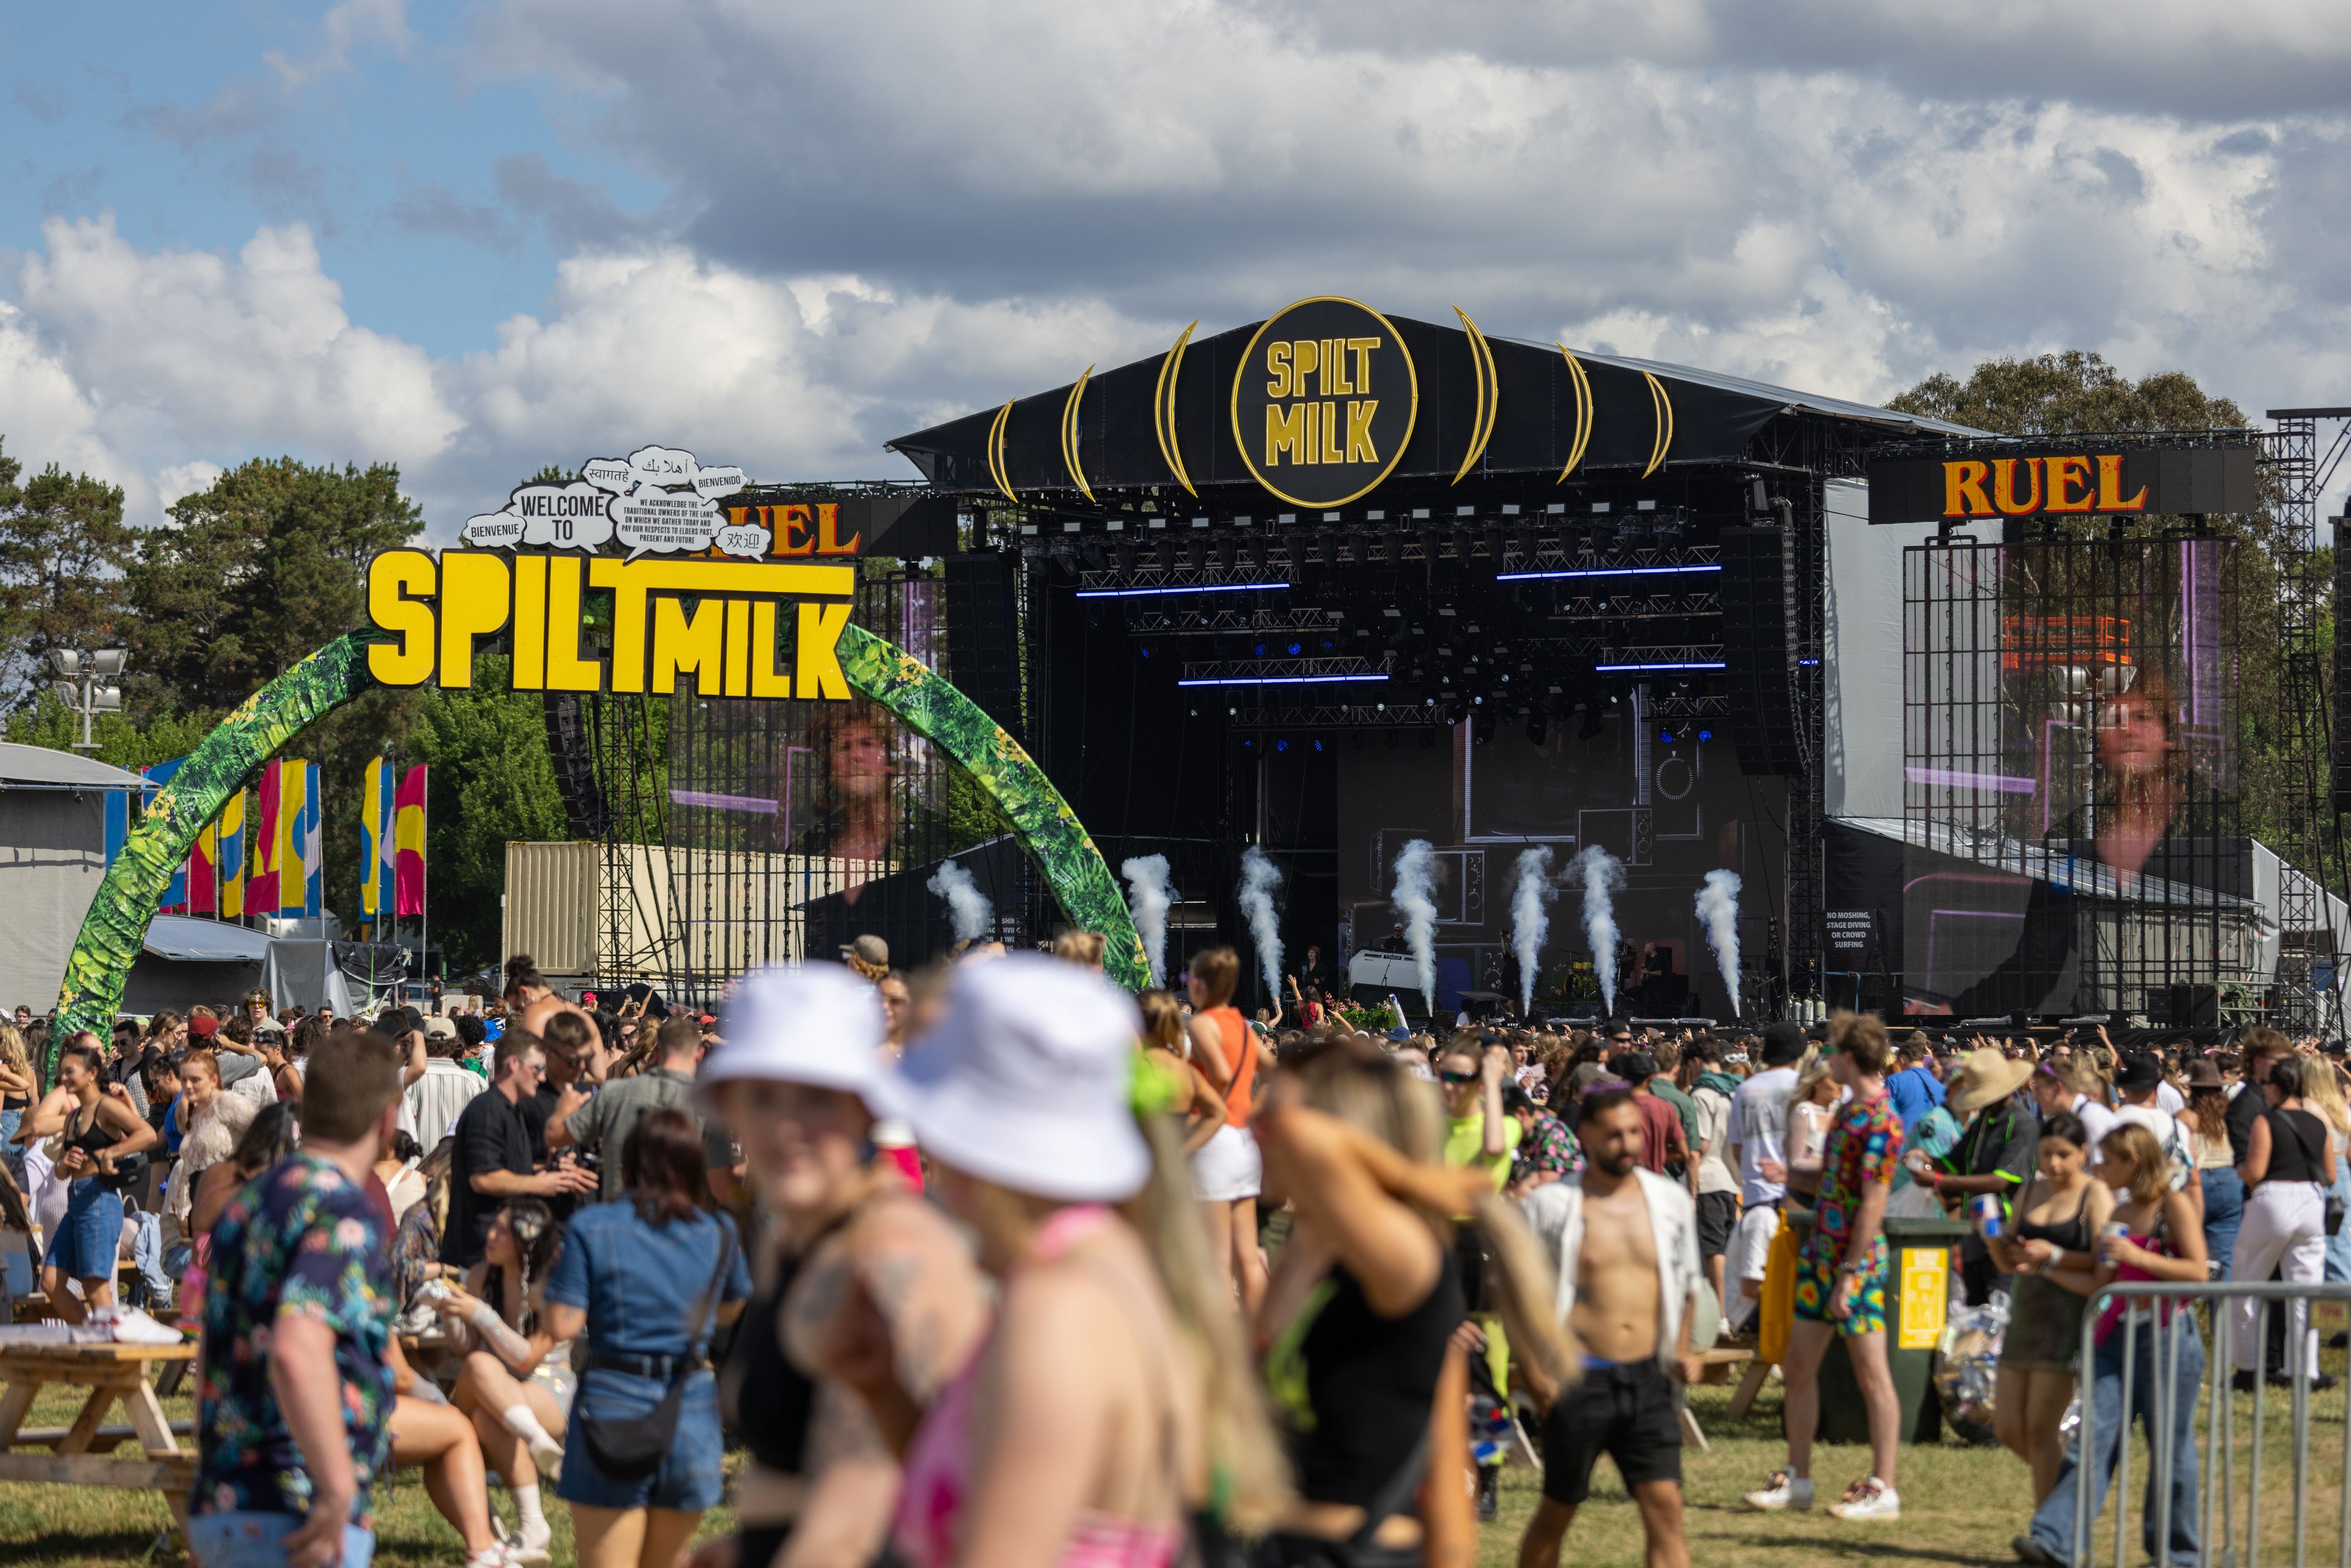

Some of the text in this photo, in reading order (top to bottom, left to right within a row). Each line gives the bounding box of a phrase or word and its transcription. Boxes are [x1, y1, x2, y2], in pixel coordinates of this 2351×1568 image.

[1267, 337, 1381, 399] SPILT
[1265, 400, 1379, 467] MILK
[699, 476, 741, 489] BIENVENIDO
[1941, 454, 2148, 517] RUEL
[521, 495, 604, 517] WELCOME
[624, 507, 657, 516] TRADITIONAL
[649, 500, 687, 508] ACKNOWLEDGE
[471, 523, 519, 538] BIENVENUE
[552, 519, 573, 540] TO
[727, 533, 759, 549] 欢迎
[368, 551, 854, 700] SPILT MILK
